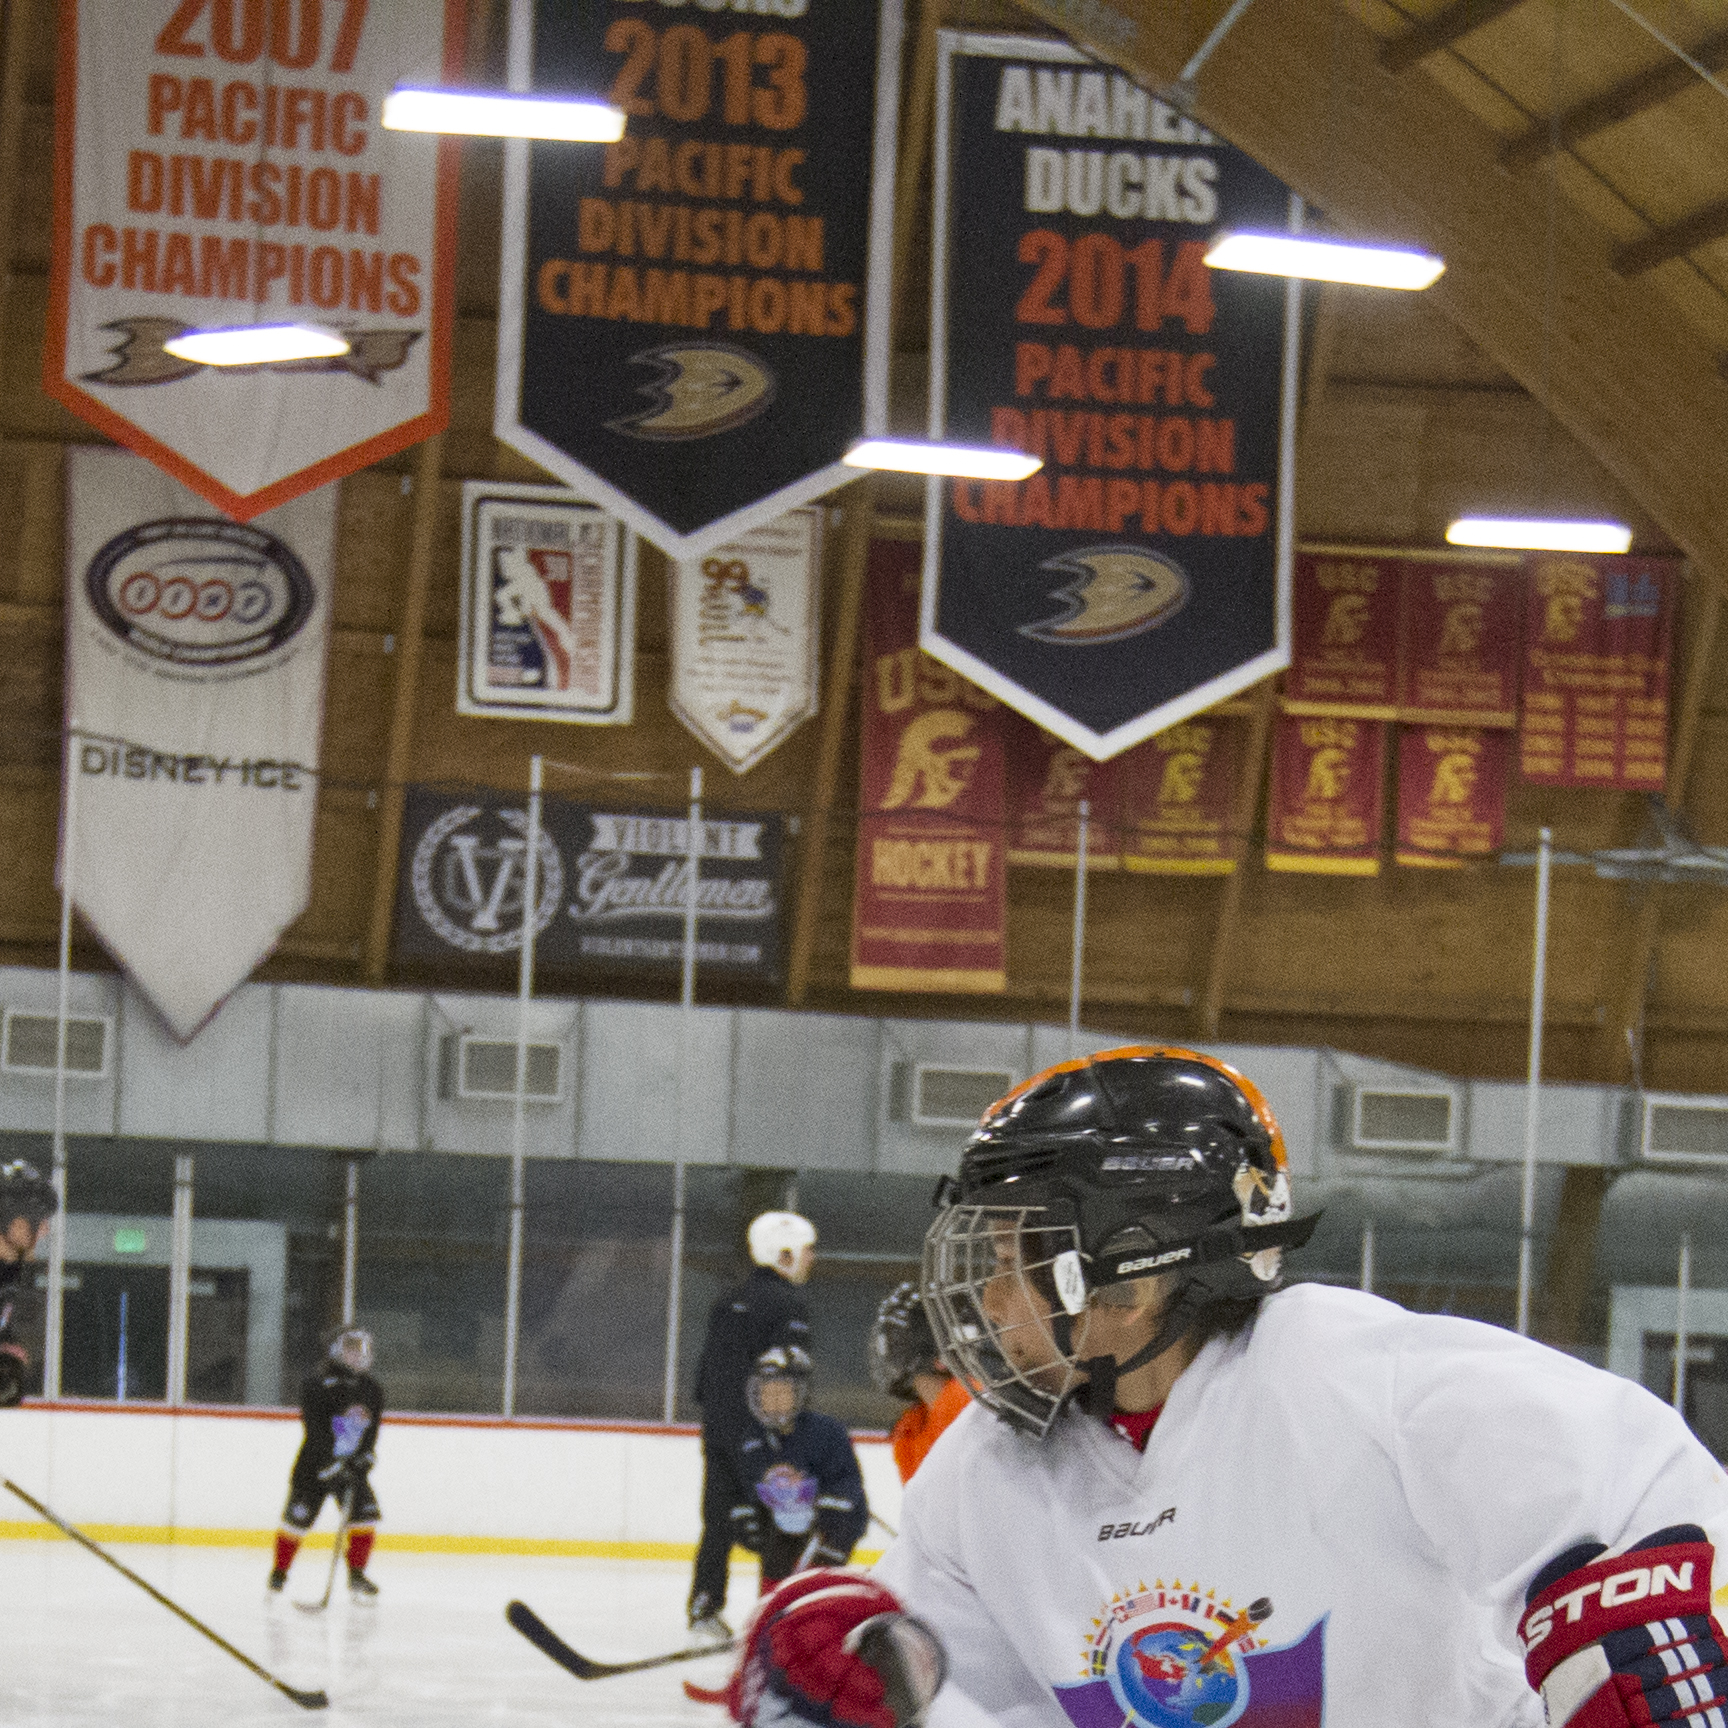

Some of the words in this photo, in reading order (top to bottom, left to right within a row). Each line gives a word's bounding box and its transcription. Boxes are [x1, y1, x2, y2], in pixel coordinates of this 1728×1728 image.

[604, 17, 809, 131] 2013
[146, 73, 370, 156] PACIFIC
[126, 149, 382, 237] DIVISION
[603, 136, 808, 206] PACIFIC
[1024, 146, 1220, 225] DUCKS
[81, 222, 423, 318] CHAMPIONS
[578, 197, 825, 272] DIVISION
[536, 257, 857, 338] CHAMPIONS
[1015, 229, 1218, 336] 2014
[1014, 342, 1217, 409] PACIFIC
[989, 405, 1236, 474] DIVISION
[952, 474, 1270, 538] CHAMPIONS
[79, 743, 232, 788] DISNEY
[239, 757, 303, 791] ICE
[612, 817, 739, 856] VIOLNT
[574, 850, 771, 917] Gentlmen
[1116, 1248, 1191, 1275] BAUER
[1519, 1561, 1694, 1652] STON
